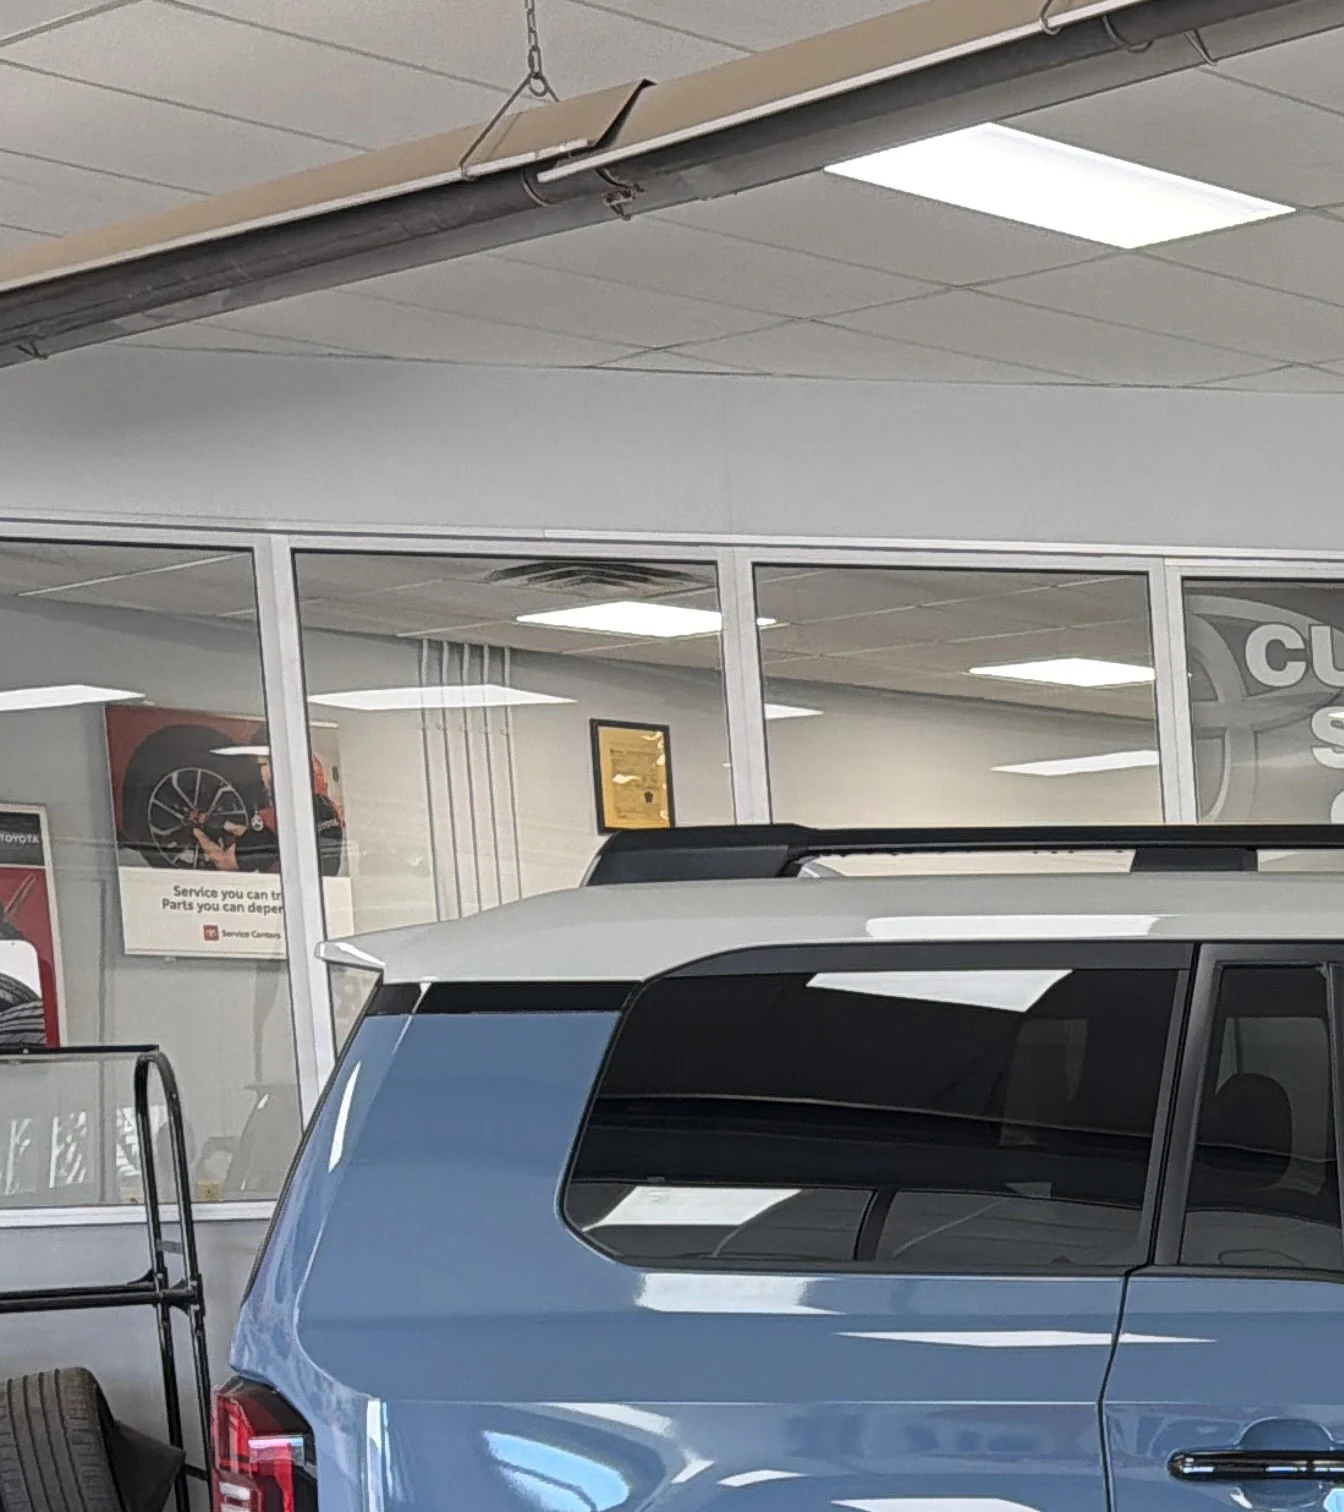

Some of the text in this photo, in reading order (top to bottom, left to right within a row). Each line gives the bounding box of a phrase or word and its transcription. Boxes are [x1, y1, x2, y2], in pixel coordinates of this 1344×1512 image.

[0, 833, 39, 844] TOYOTA
[173, 885, 218, 899] Service
[221, 889, 244, 900] you
[246, 890, 268, 900] can
[162, 899, 194, 911] Parts
[197, 902, 220, 913] you
[222, 902, 245, 912] can
[221, 929, 249, 938] Service
